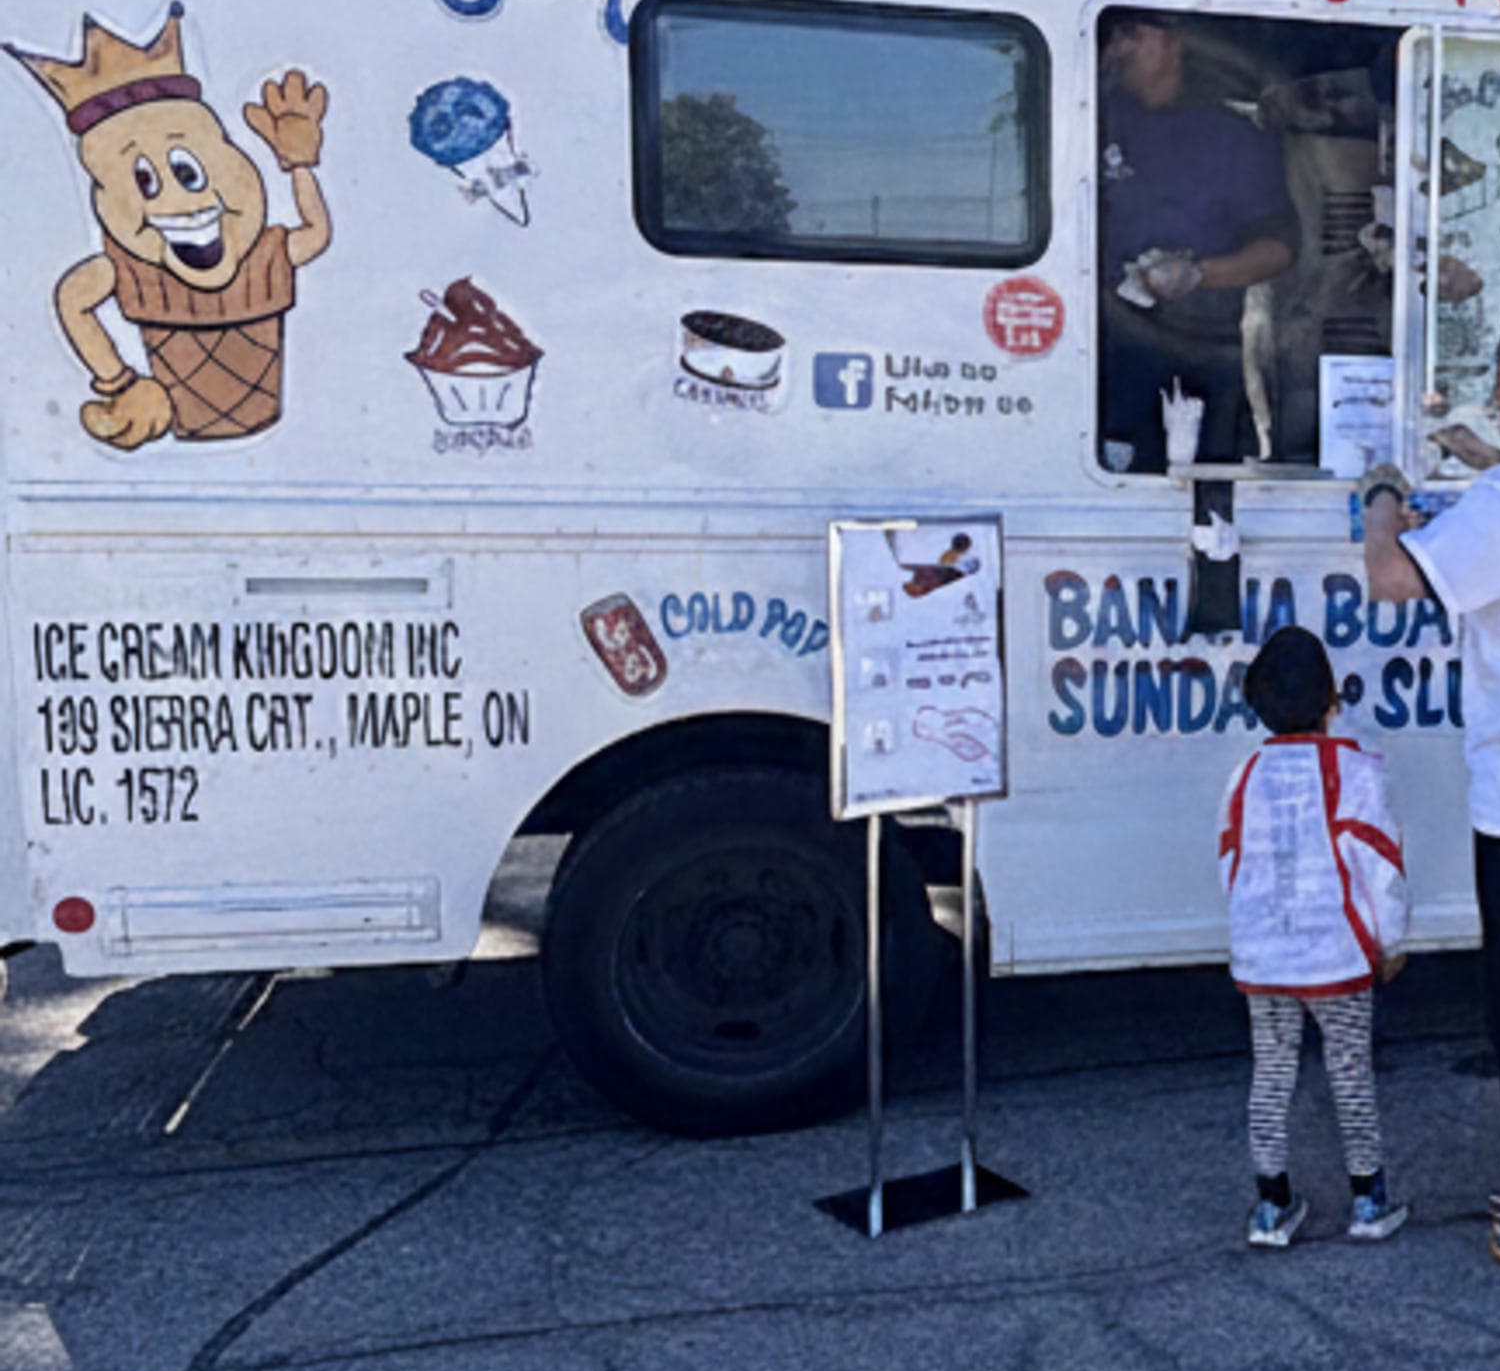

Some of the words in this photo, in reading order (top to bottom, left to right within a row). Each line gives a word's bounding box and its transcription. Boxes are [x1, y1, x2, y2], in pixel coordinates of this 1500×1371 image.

[660, 591, 756, 640] COLD
[34, 623, 89, 681] ICE
[99, 622, 223, 681] CREAM
[406, 621, 462, 679] INC
[110, 694, 238, 754] SIERRA
[481, 689, 531, 747] ON
[116, 766, 200, 824] 1572
